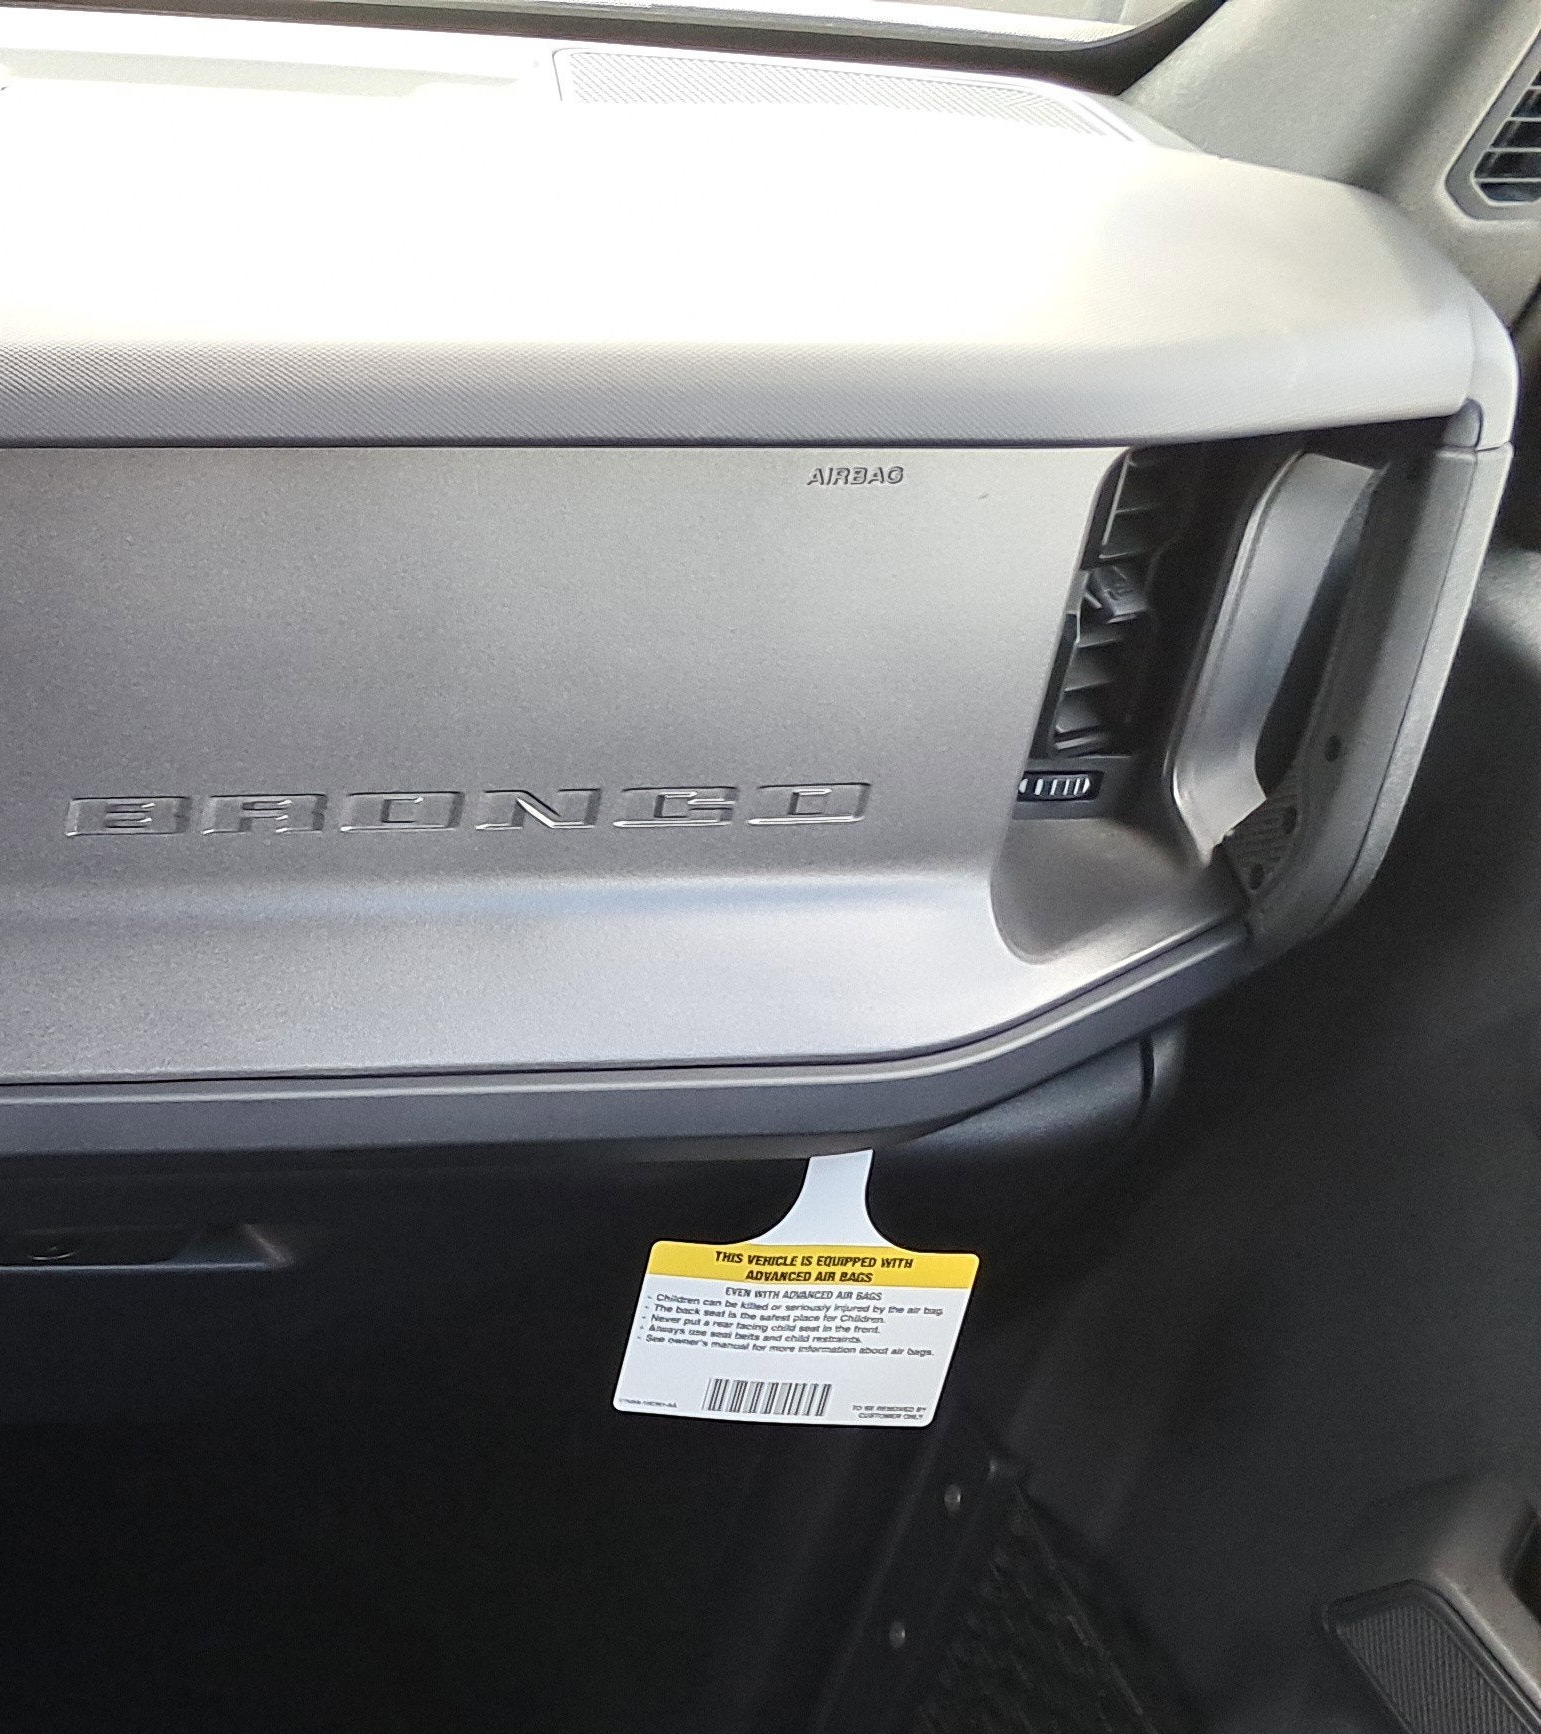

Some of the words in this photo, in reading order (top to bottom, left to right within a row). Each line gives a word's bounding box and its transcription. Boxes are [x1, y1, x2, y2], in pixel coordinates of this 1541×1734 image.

[806, 465, 904, 486] AIRBAG
[64, 782, 873, 838] BRONCO
[715, 1250, 744, 1264] THIS
[747, 1254, 798, 1267] VEHICLE
[801, 1255, 813, 1267] IS
[816, 1255, 877, 1268] EQUIPPED
[881, 1257, 914, 1269] WITH
[745, 1270, 812, 1282] ADVANCED
[814, 1271, 837, 1283] AIR
[839, 1272, 874, 1283] BAGS
[725, 1286, 751, 1298] EVEN
[754, 1289, 780, 1299] WITH
[782, 1290, 834, 1300] ADVANCED
[835, 1291, 853, 1300] AIR
[856, 1291, 883, 1301] BAGS
[654, 1303, 673, 1313] The
[675, 1305, 701, 1315] back
[703, 1308, 726, 1318] seat
[727, 1310, 737, 1319] is
[739, 1311, 758, 1321] the
[759, 1313, 791, 1323] safest
[793, 1313, 822, 1323] place
[823, 1314, 838, 1323] for
[656, 1293, 701, 1305] Children
[725, 1300, 738, 1309] be
[740, 1300, 769, 1311] killed
[784, 1303, 831, 1315] seriously
[833, 1303, 870, 1314] injured
[872, 1305, 886, 1315] by
[888, 1306, 905, 1314] the
